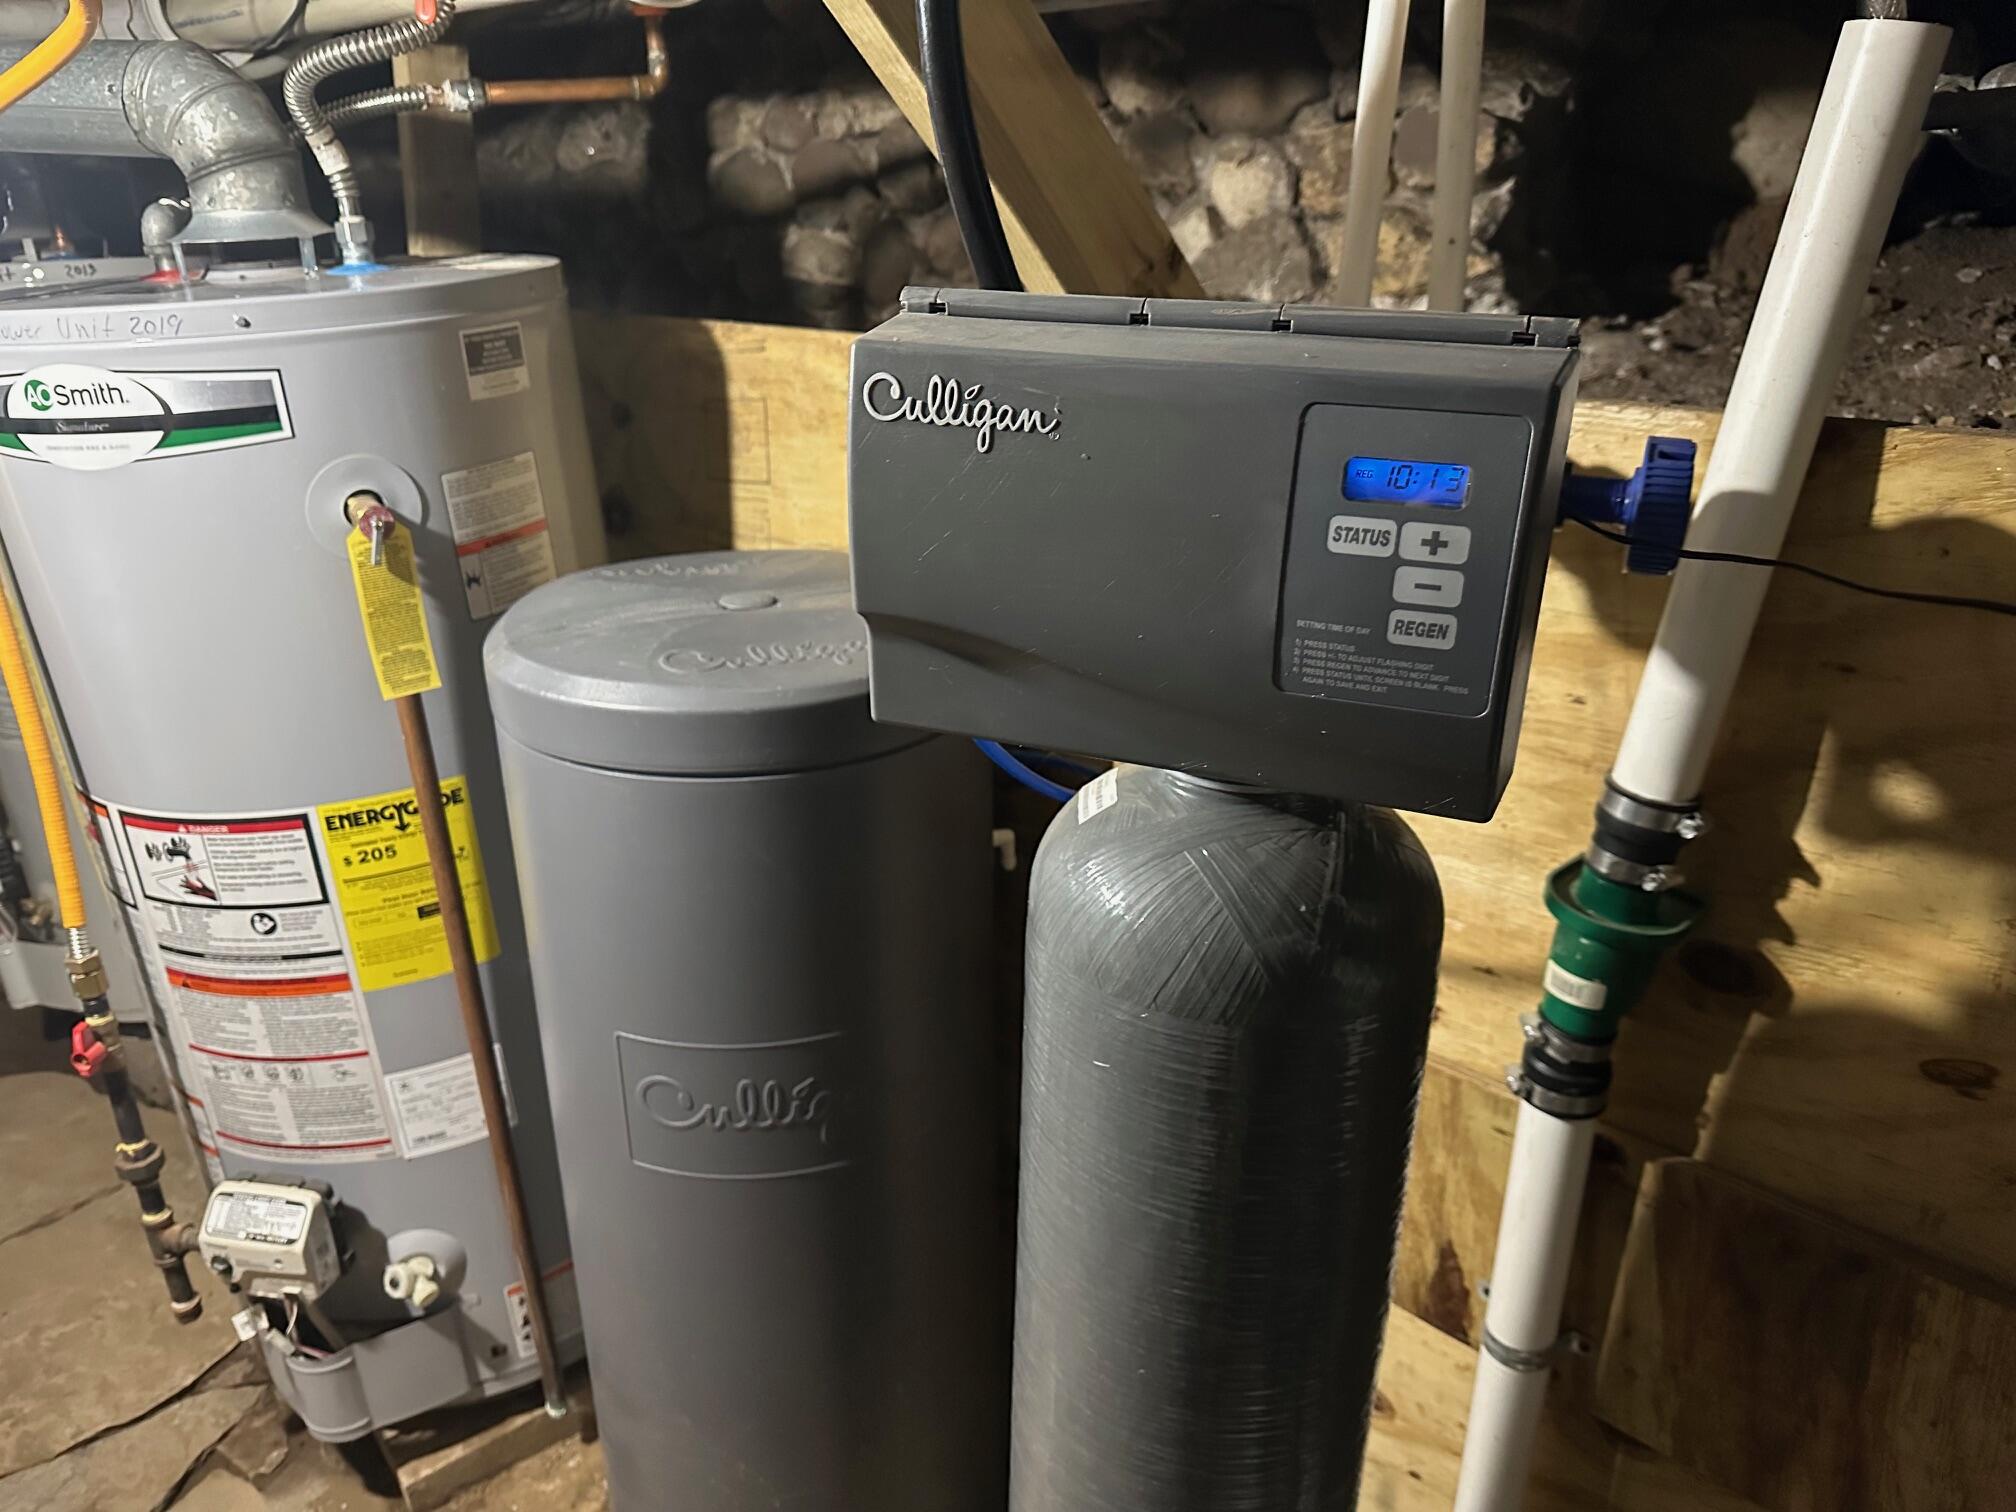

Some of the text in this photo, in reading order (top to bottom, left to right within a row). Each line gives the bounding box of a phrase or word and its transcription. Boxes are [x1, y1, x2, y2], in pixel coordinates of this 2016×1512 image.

[56, 312, 115, 339] Unit
[129, 314, 183, 337] 2019
[863, 371, 1057, 453] Culligan
[1387, 464, 1465, 492] 10:13
[1332, 525, 1391, 547] STATUS
[1296, 619, 1371, 635] SETTING TIME OF DAY
[1393, 619, 1449, 640] REGEN
[1303, 639, 1327, 649] PRESS
[658, 641, 868, 674] Culliga
[325, 787, 464, 831] ENERGYGDE
[356, 844, 397, 865] 205
